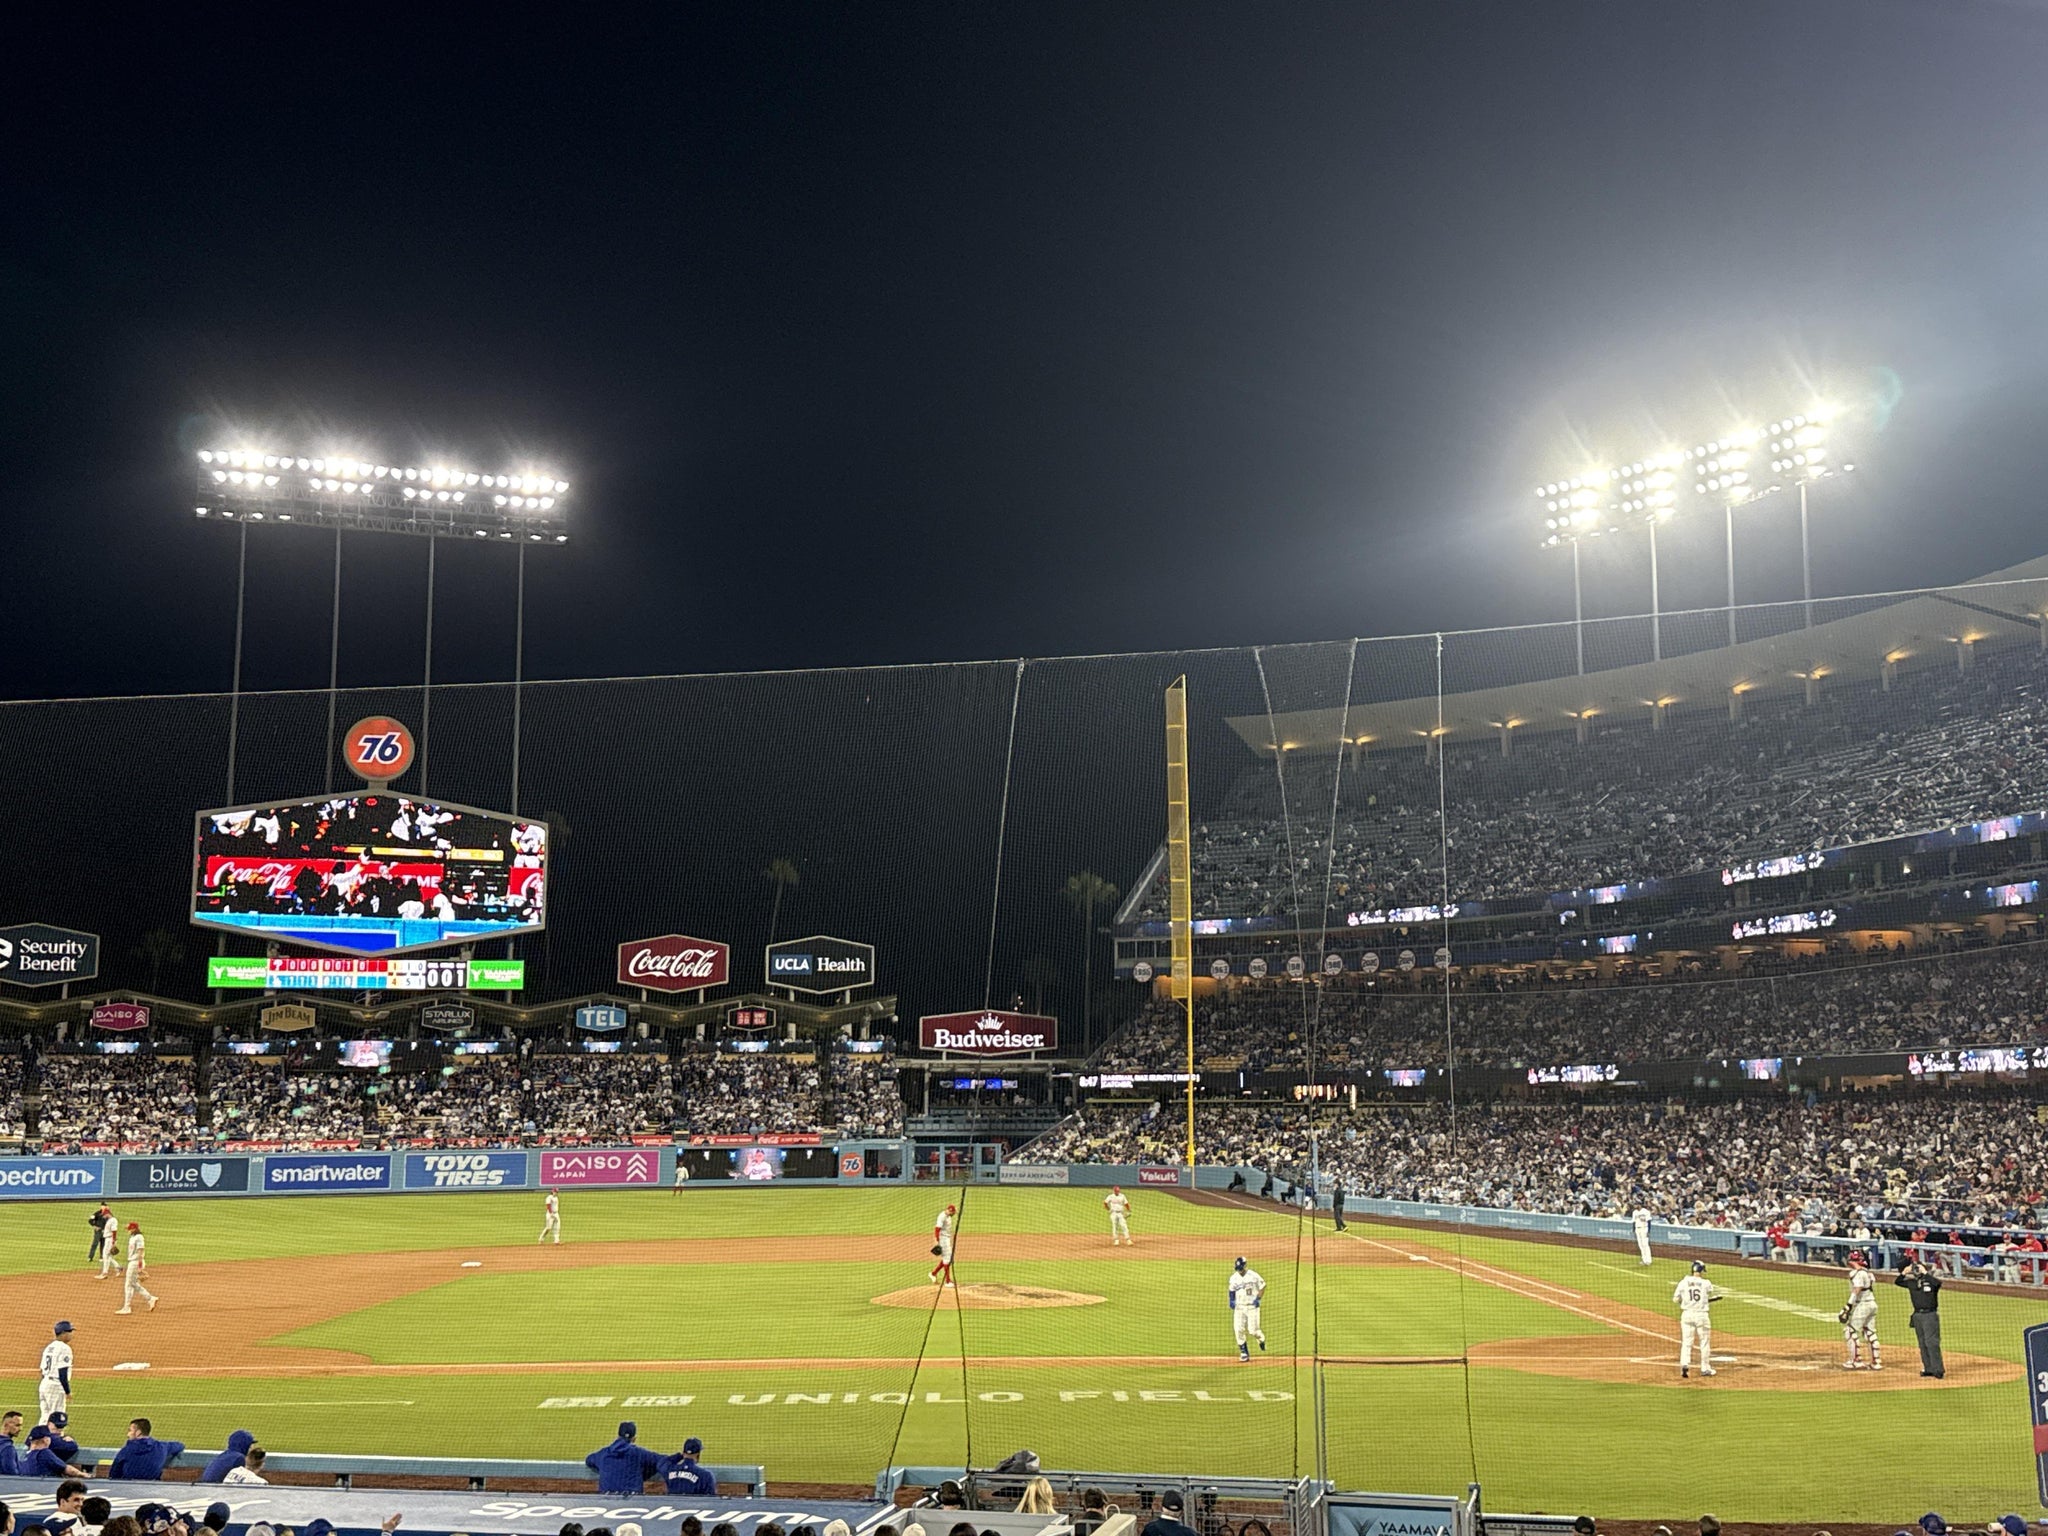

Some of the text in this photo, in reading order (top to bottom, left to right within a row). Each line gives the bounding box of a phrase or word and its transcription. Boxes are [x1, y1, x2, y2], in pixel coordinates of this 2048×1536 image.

[357, 732, 402, 764] 76
[402, 874, 442, 889] TME
[20, 938, 87, 958] Security
[19, 955, 76, 971] Benefit
[628, 948, 719, 978] Coca-Cola
[775, 957, 866, 972] UCLA Health
[427, 969, 439, 987] 0
[441, 969, 453, 987] 0
[457, 969, 464, 987] 1
[264, 1006, 310, 1026] JIM BEAM
[425, 1010, 471, 1018] STARLUX
[582, 1010, 620, 1027] TEL
[424, 1154, 490, 1171] TOYO
[552, 1156, 622, 1170] DAISO
[843, 1158, 861, 1172] 76
[149, 1163, 199, 1182] blue
[271, 1164, 385, 1182] smartwater
[434, 1170, 505, 1186] TIRES
[552, 1171, 586, 1179] JAPAN
[1141, 1171, 1178, 1182] Yakult
[1688, 1289, 1701, 1302] 16
[44, 1354, 52, 1371] 31
[727, 1390, 1296, 1405] UNIQLO FIELD
[469, 1501, 805, 1527] Spectrum
